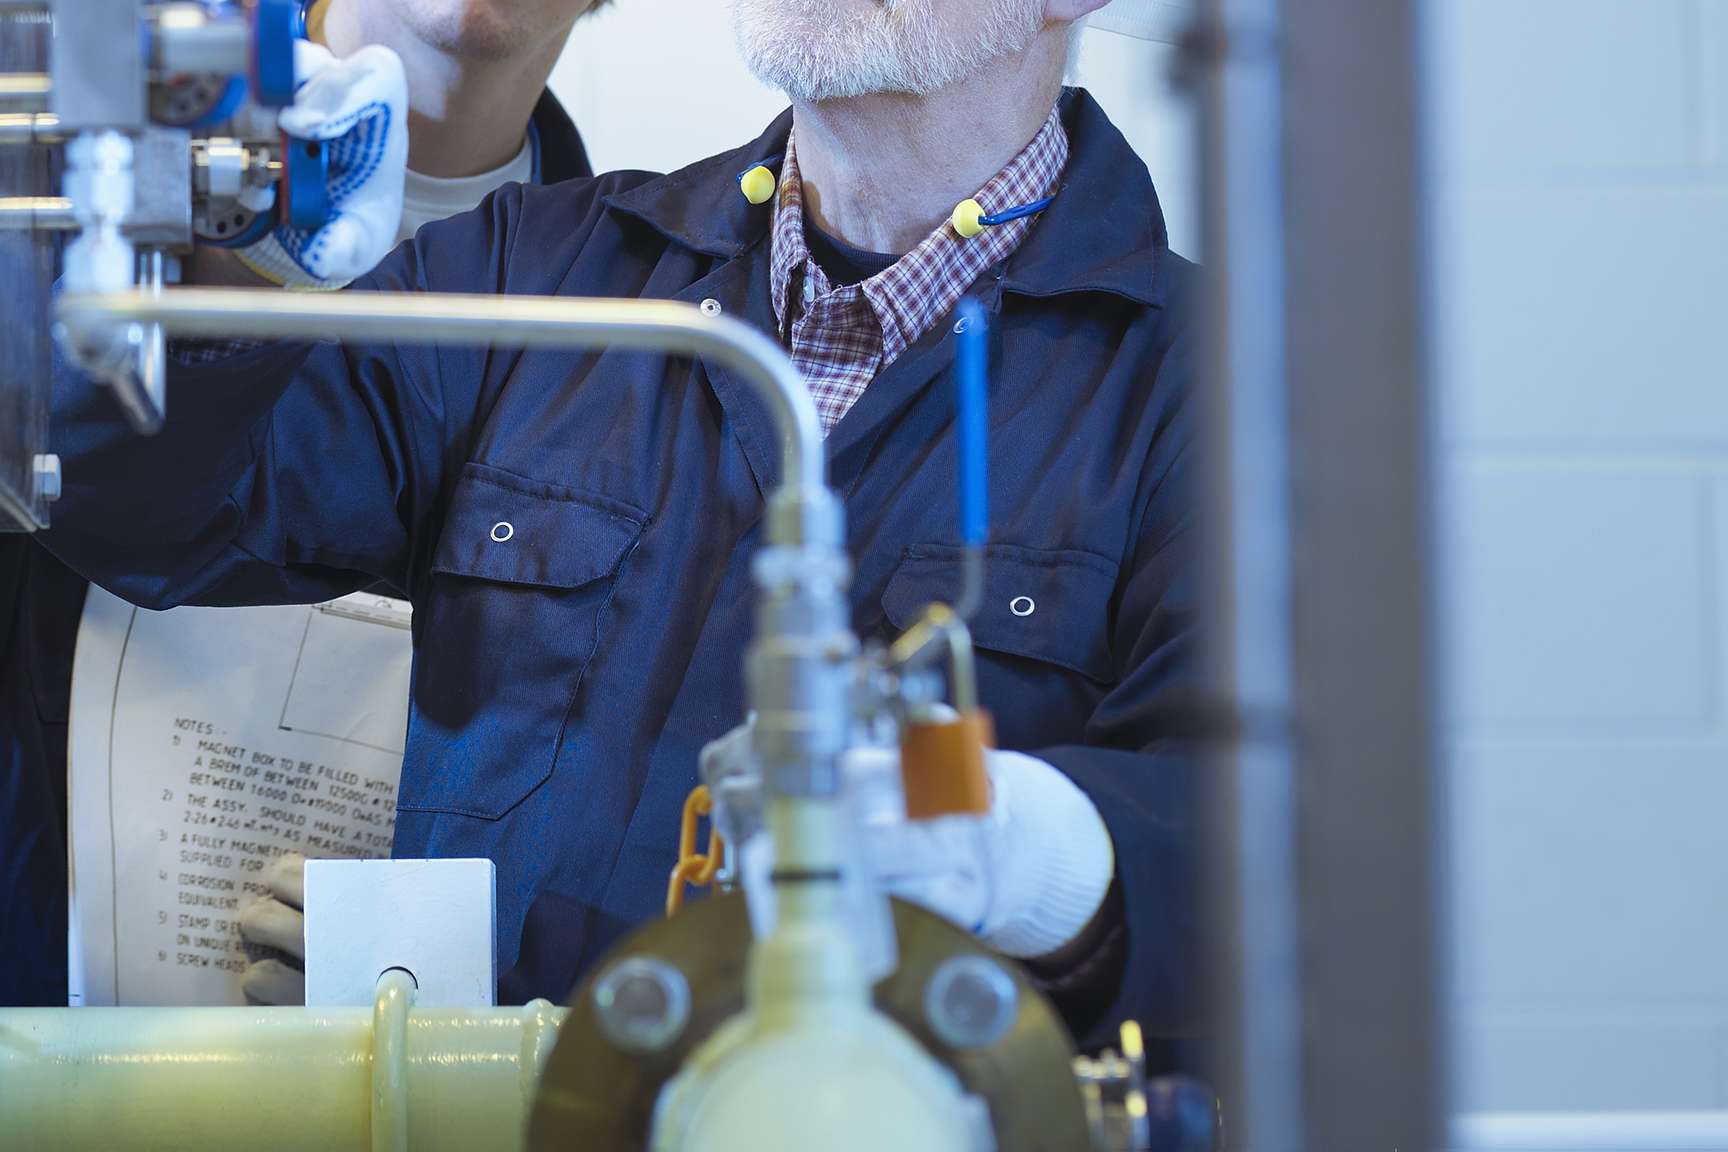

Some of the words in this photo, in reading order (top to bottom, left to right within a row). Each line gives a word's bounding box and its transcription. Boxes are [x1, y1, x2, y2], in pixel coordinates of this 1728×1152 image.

[175, 718, 213, 735] NOTES
[194, 755, 202, 766] A
[209, 758, 241, 774] BREM
[244, 766, 259, 777] OF
[264, 769, 320, 791] BETWEEN
[198, 740, 246, 758] MAGNET
[252, 752, 275, 765] BOX
[281, 758, 294, 771] TO
[298, 762, 313, 775] BE
[318, 765, 358, 785] FILLED
[365, 778, 394, 794] WITH
[190, 772, 245, 791] BETWEEN
[188, 793, 208, 808] THE
[260, 806, 305, 826] SHOULD
[314, 820, 345, 839] HAVE
[192, 834, 226, 849] FULLY
[283, 829, 301, 842] AS
[307, 835, 371, 857] MEASURED
[180, 849, 232, 868] SUPPLIED
[240, 858, 264, 871] FOR
[178, 873, 235, 891] CORROSION
[178, 914, 209, 929] STAMP
[177, 953, 208, 968] SCREW
[214, 958, 246, 974] HEADS
